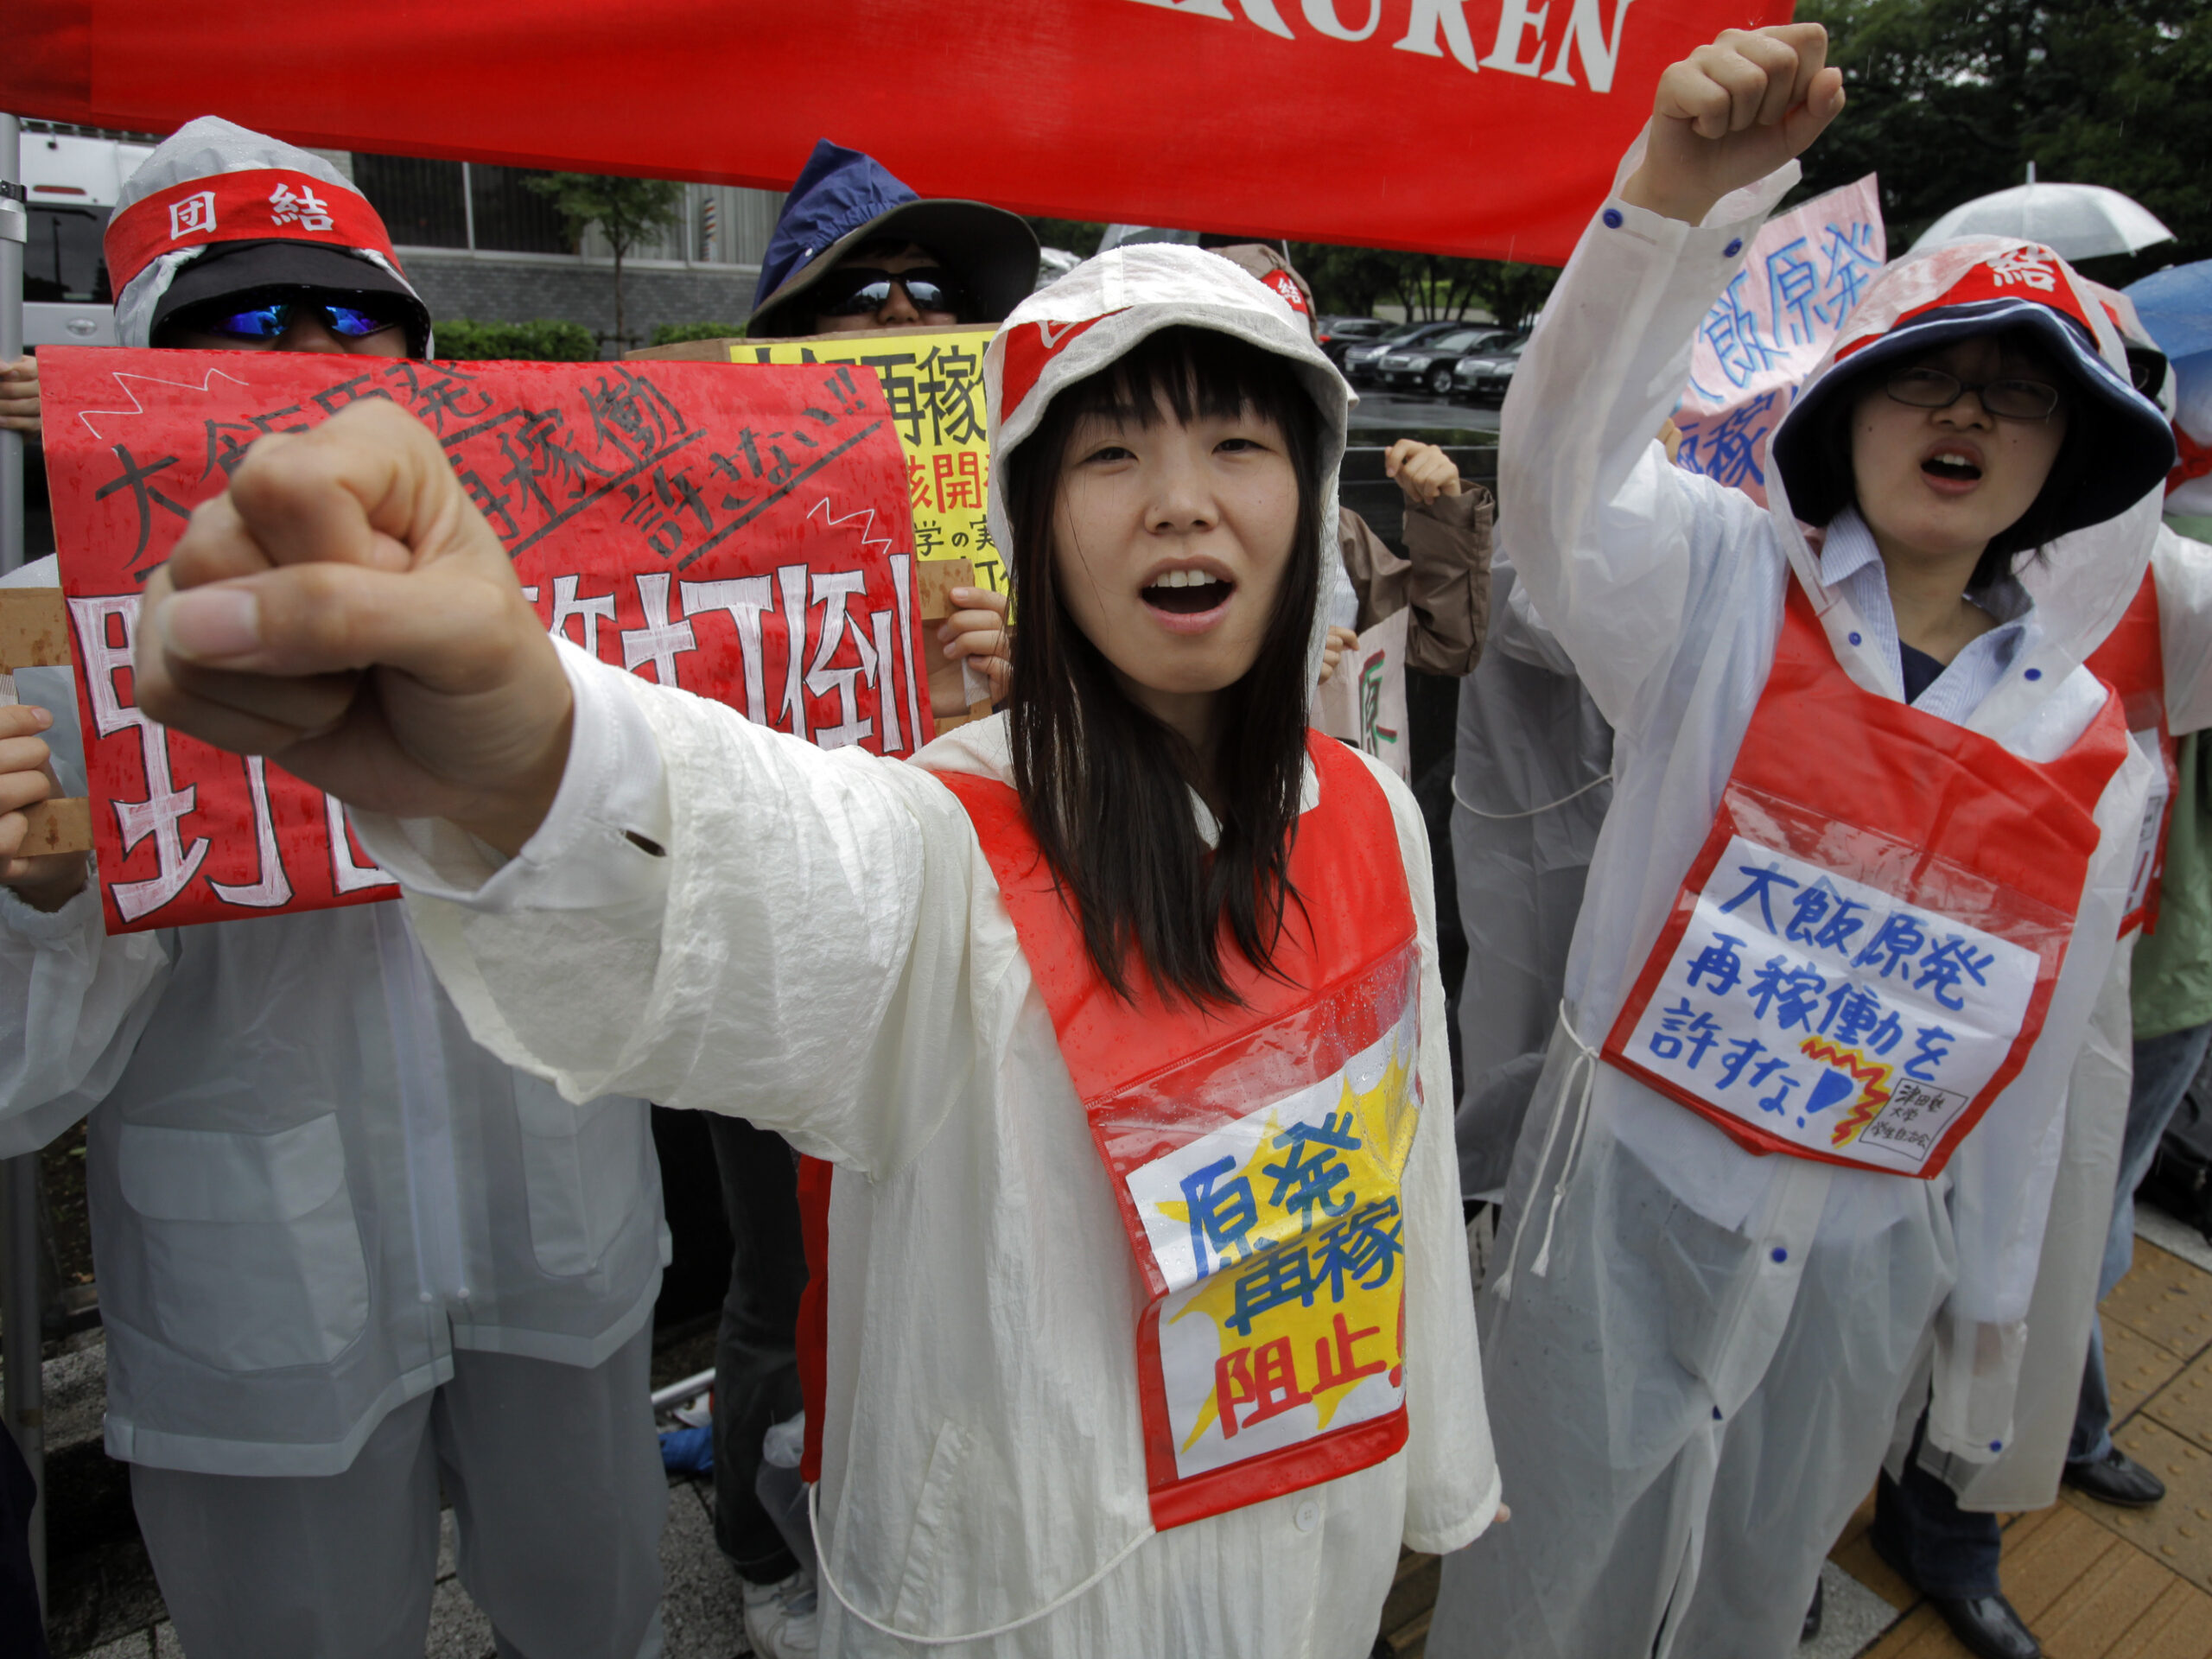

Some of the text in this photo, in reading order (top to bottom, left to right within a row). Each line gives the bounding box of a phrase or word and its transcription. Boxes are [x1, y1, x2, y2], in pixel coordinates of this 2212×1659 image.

[168, 182, 334, 240] 団結
[1986, 245, 2056, 292] 結
[1673, 221, 1882, 416] 飯原発
[1687, 931, 1956, 1081] 再稼働を
[1719, 861, 1995, 1011] 大飯原発
[1649, 997, 1853, 1128] 許すな!
[1179, 1111, 1362, 1281] 原発
[1224, 1195, 1403, 1336] 再稼
